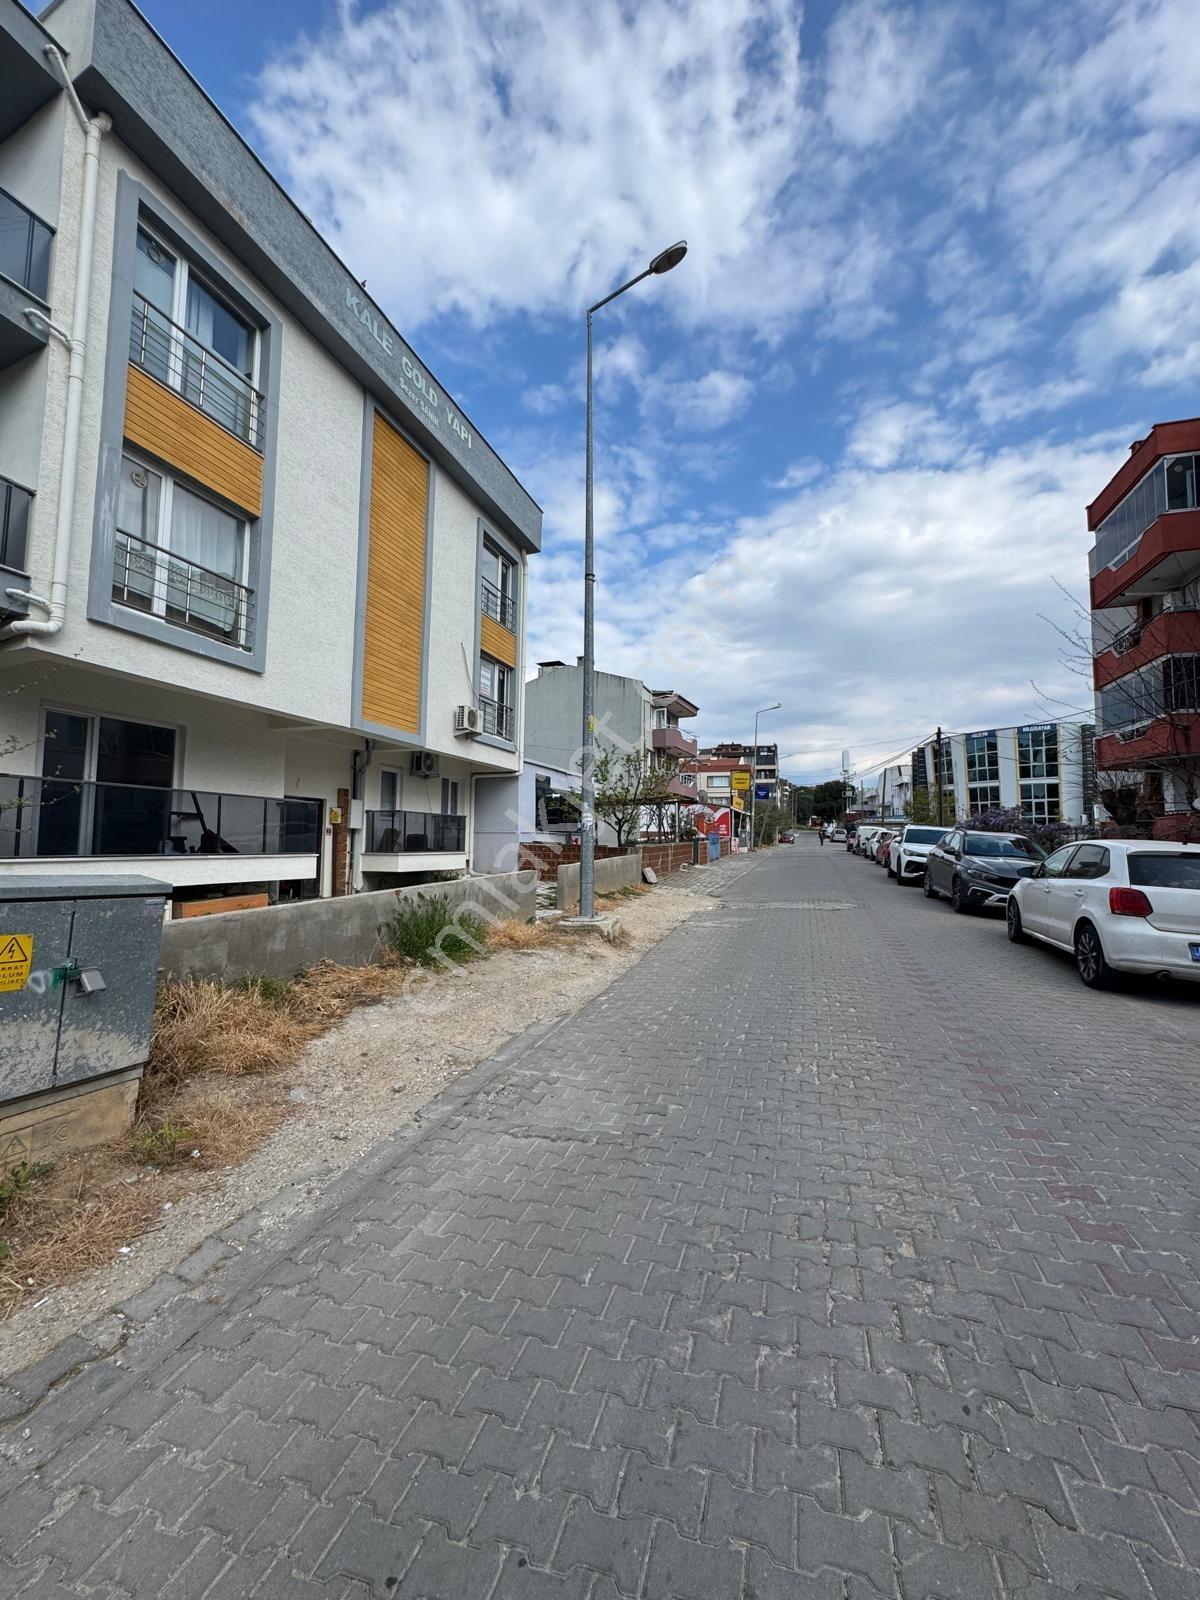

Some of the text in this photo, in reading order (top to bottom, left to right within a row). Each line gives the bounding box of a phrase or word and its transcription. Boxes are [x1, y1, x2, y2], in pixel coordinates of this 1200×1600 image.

[346, 288, 472, 449] KALE GOLD YAPI
